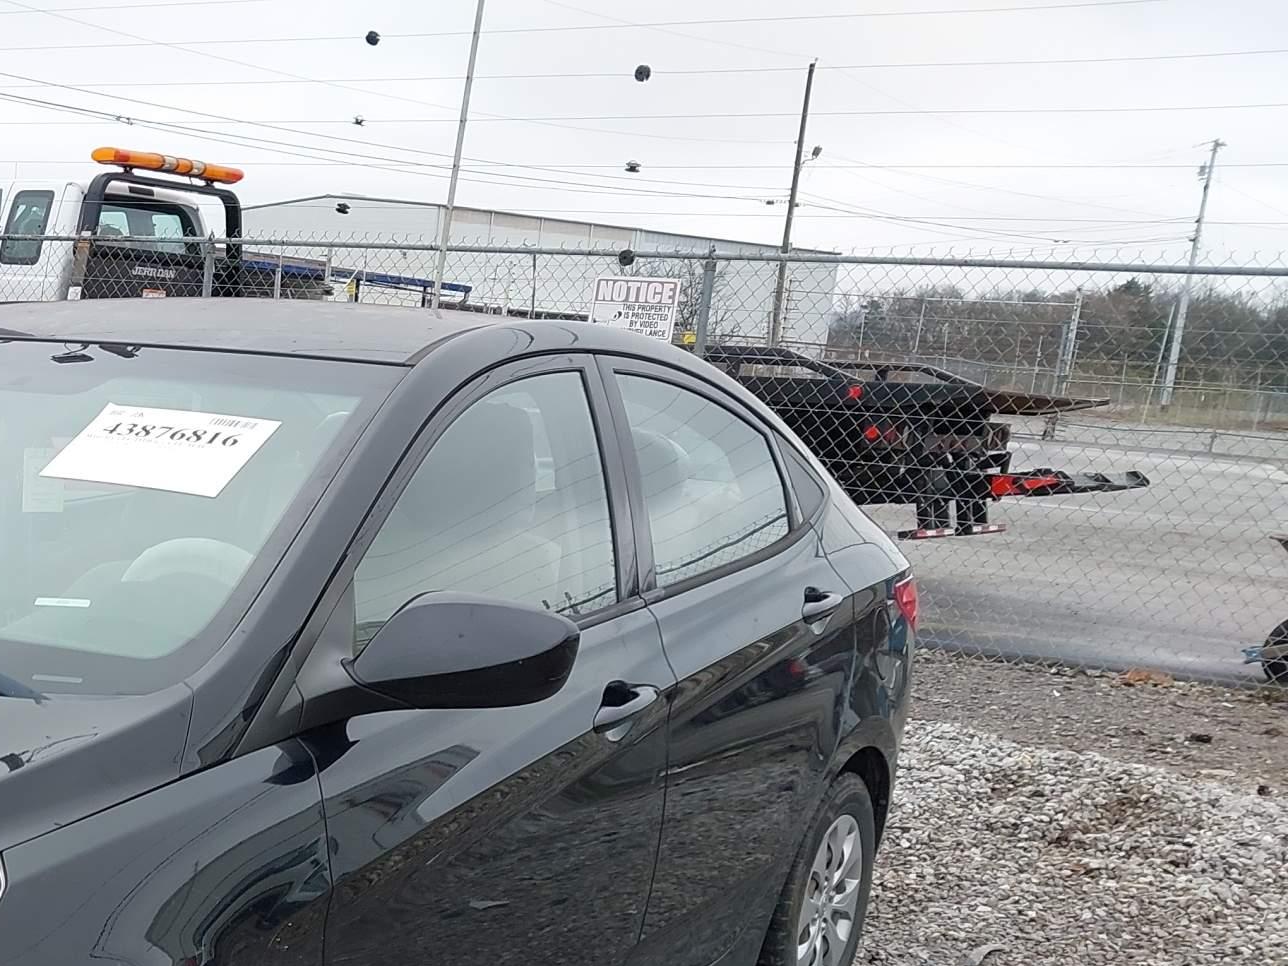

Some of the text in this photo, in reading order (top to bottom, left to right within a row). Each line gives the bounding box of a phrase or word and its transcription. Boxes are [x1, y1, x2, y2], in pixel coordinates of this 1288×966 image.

[597, 280, 675, 304] NOTICE
[623, 303, 672, 313] THIS PROPERTY
[624, 311, 669, 321] IS PROTECTED
[629, 319, 659, 329] BY VIDEO
[103, 422, 243, 448] 43876816
